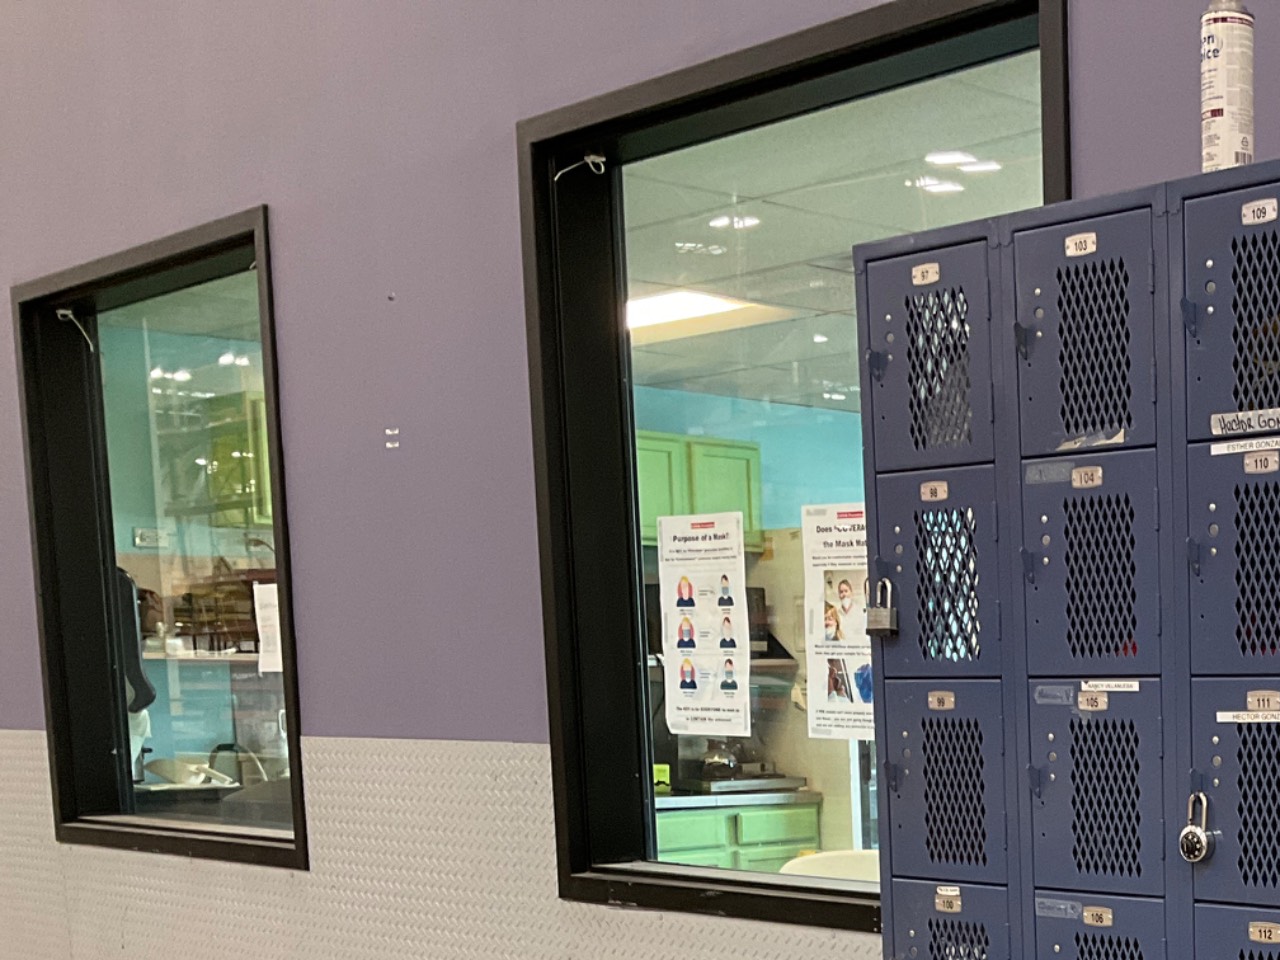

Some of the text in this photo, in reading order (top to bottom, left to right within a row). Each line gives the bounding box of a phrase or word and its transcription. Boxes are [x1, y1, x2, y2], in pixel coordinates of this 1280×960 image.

[1200, 48, 1220, 63] ice
[1252, 207, 1267, 220] 109
[1074, 240, 1087, 252] 103
[921, 270, 929, 281] 97
[1226, 442, 1254, 452] ESTHER
[1254, 457, 1269, 469] 110
[1079, 472, 1094, 485] 104
[929, 488, 938, 498] 98
[816, 525, 833, 533] Does
[672, 535, 699, 543] Purpose
[713, 532, 729, 540] Mask?
[835, 539, 854, 548] Mask
[936, 697, 946, 707] 99
[1085, 697, 1099, 708] 105
[1256, 697, 1270, 709] 111
[942, 900, 954, 910] 100
[1090, 914, 1104, 924] 106
[1257, 928, 1273, 940] 112
